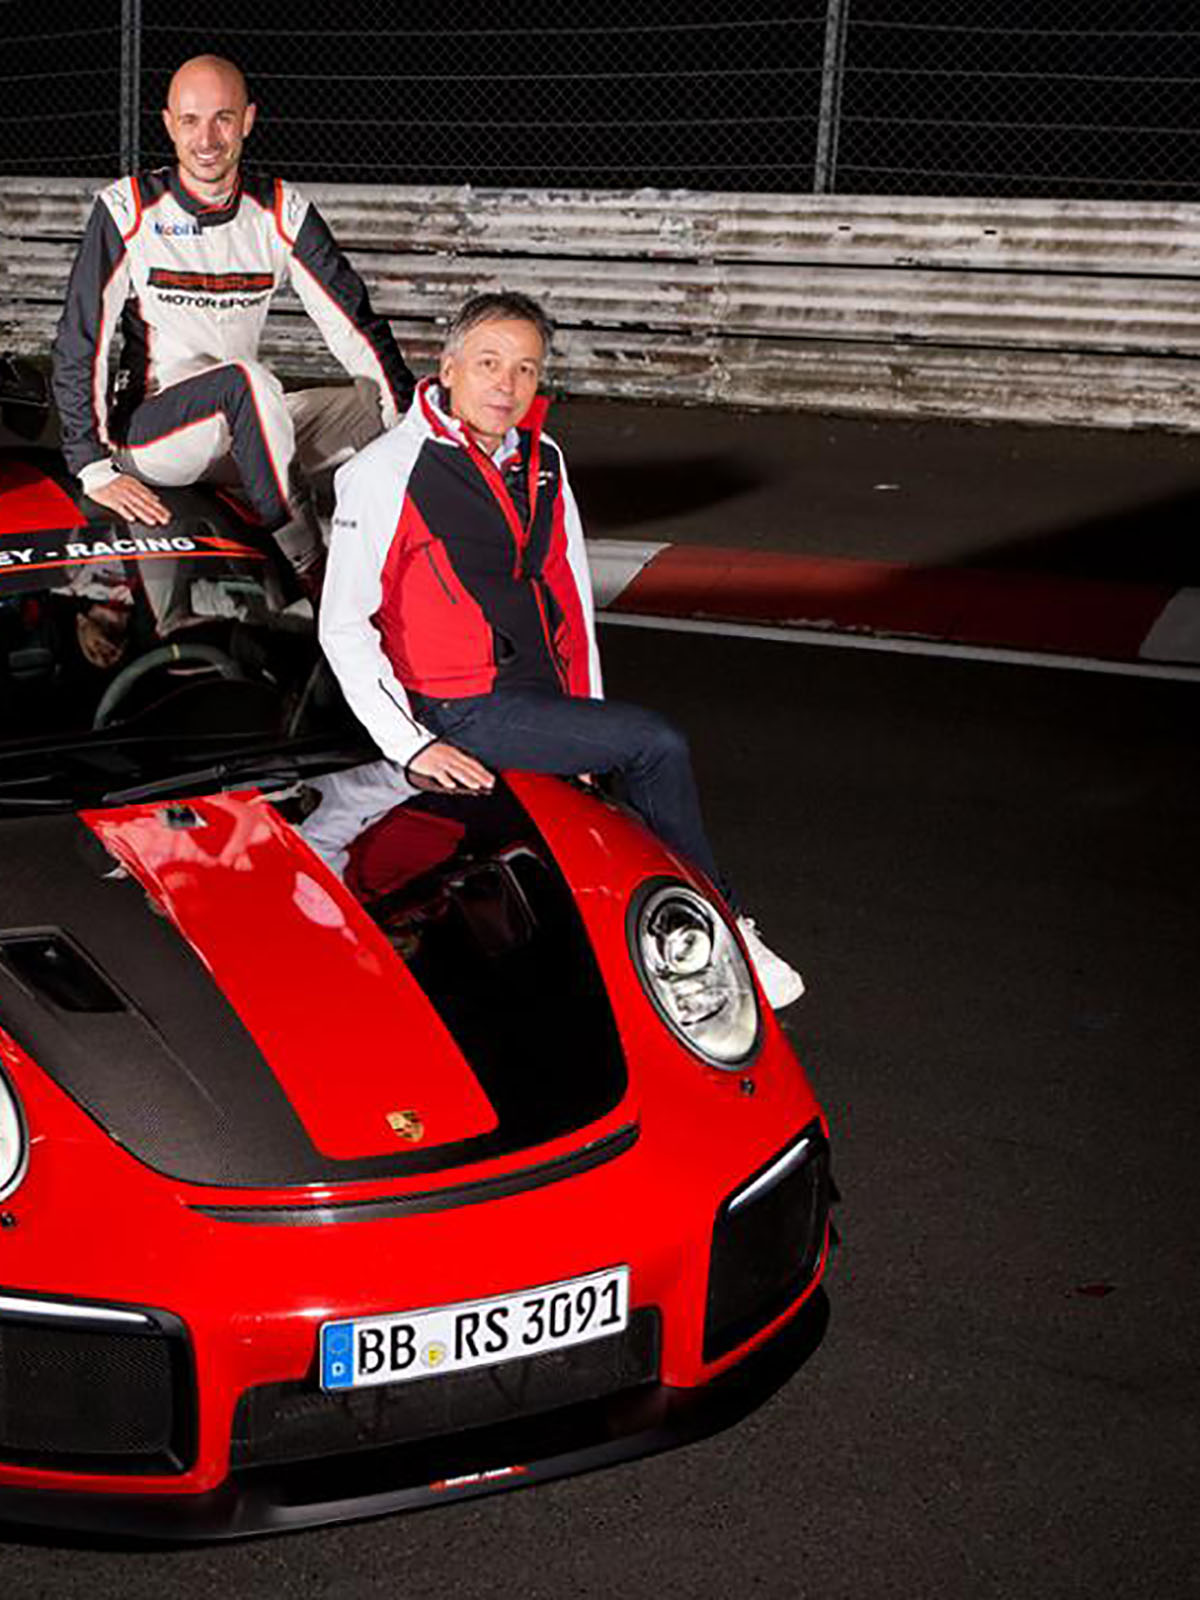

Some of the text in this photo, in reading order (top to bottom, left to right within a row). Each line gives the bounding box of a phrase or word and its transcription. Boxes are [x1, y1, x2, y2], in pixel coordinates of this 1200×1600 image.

[67, 537, 196, 557] RACING
[359, 1280, 621, 1374] BB RS 3091
